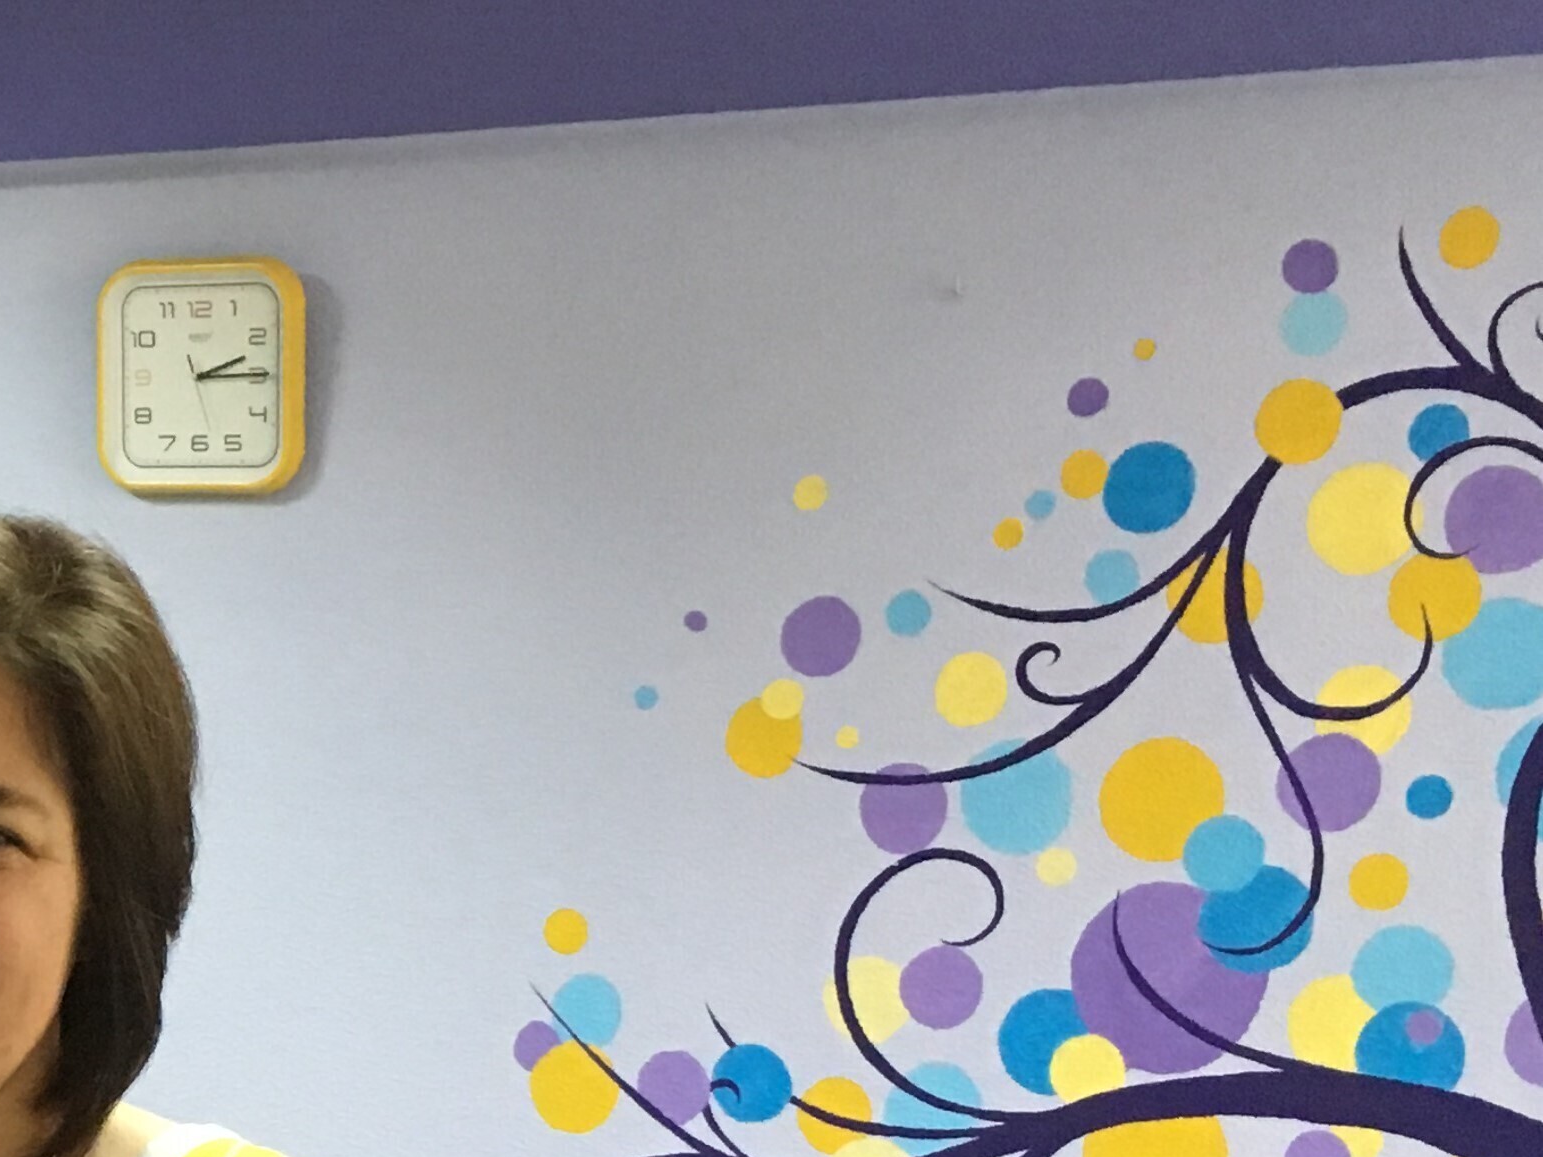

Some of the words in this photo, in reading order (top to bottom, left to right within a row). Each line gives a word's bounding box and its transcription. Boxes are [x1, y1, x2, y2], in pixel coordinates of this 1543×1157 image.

[159, 301, 175, 319] 11
[187, 300, 212, 319] 12
[230, 299, 238, 316] 1
[131, 330, 156, 348] 10
[248, 327, 267, 346] 2
[135, 369, 152, 387] 9
[248, 366, 267, 385] 3
[134, 407, 152, 424] 8
[248, 406, 267, 423] 4
[158, 434, 176, 452] 7
[190, 434, 210, 452] 6
[224, 434, 242, 452] 5
